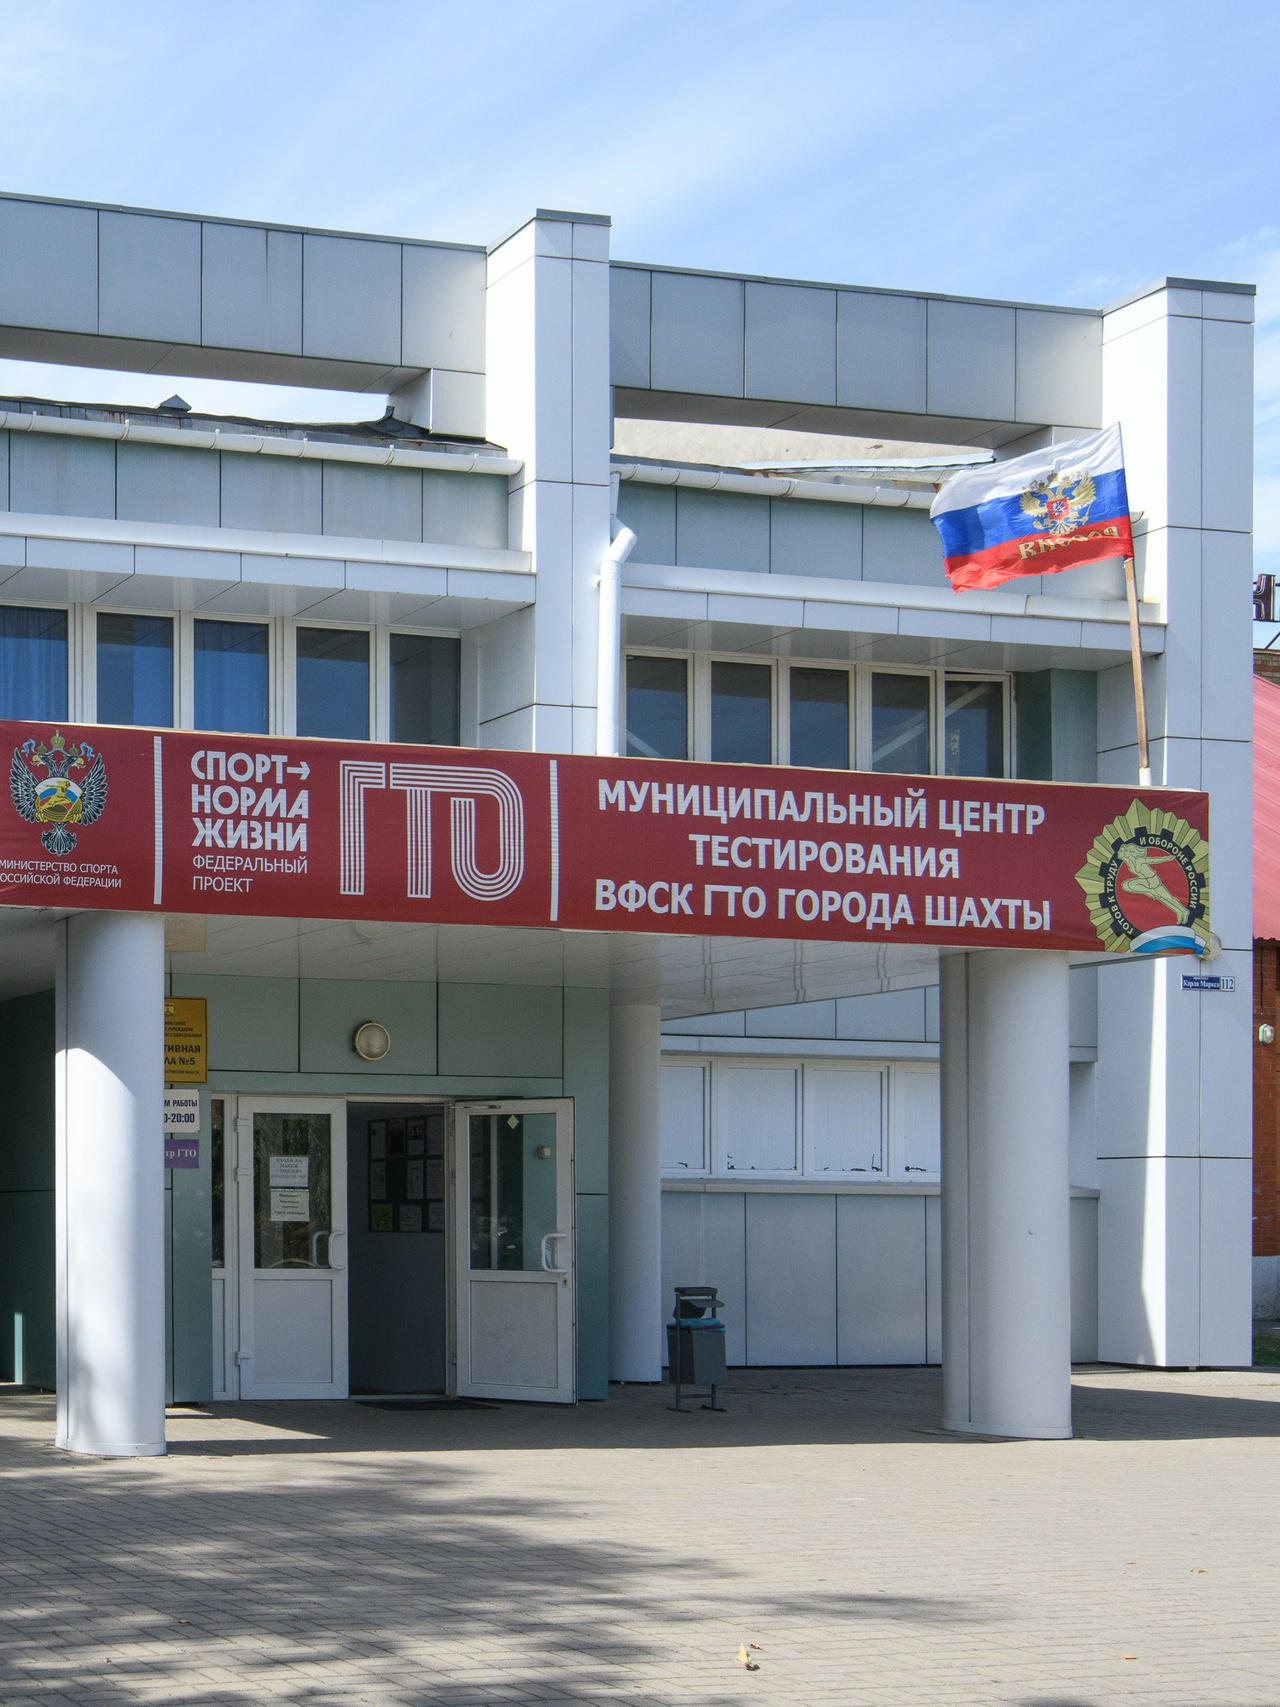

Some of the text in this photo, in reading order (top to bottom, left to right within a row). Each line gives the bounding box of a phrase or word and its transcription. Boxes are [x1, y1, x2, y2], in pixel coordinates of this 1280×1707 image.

[190, 750, 288, 784] СПОРТ
[191, 784, 309, 819] НОРМА
[598, 778, 1046, 837] МУНИЦИПАЛЬНЫЙ ЦЕНТР
[191, 817, 307, 852] ЖИЗНИ
[339, 760, 525, 902] ГТО
[1140, 837, 1146, 846] И
[192, 854, 308, 873] ФЕДЕРАЛЬНЫЙ
[688, 833, 960, 878] ТЕСТИРОВАНИЯ
[1148, 836, 1189, 866] ОБОРОНЕ
[63, 876, 122, 889] ФЕДЕРАЦИИ
[80, 863, 118, 874] СПОРТА
[1107, 860, 1118, 893] ТРУДУ
[192, 876, 253, 892] ПРОЕКТ
[1185, 866, 1198, 909] РОССИИ
[595, 878, 1051, 931] ВФСК ГТО ГОРОДА ШАХТЫ
[1111, 905, 1134, 935] ГОТОВ
[1222, 978, 1234, 989] 112
[179, 1057, 195, 1065] №5
[177, 1149, 197, 1157] ГТО
